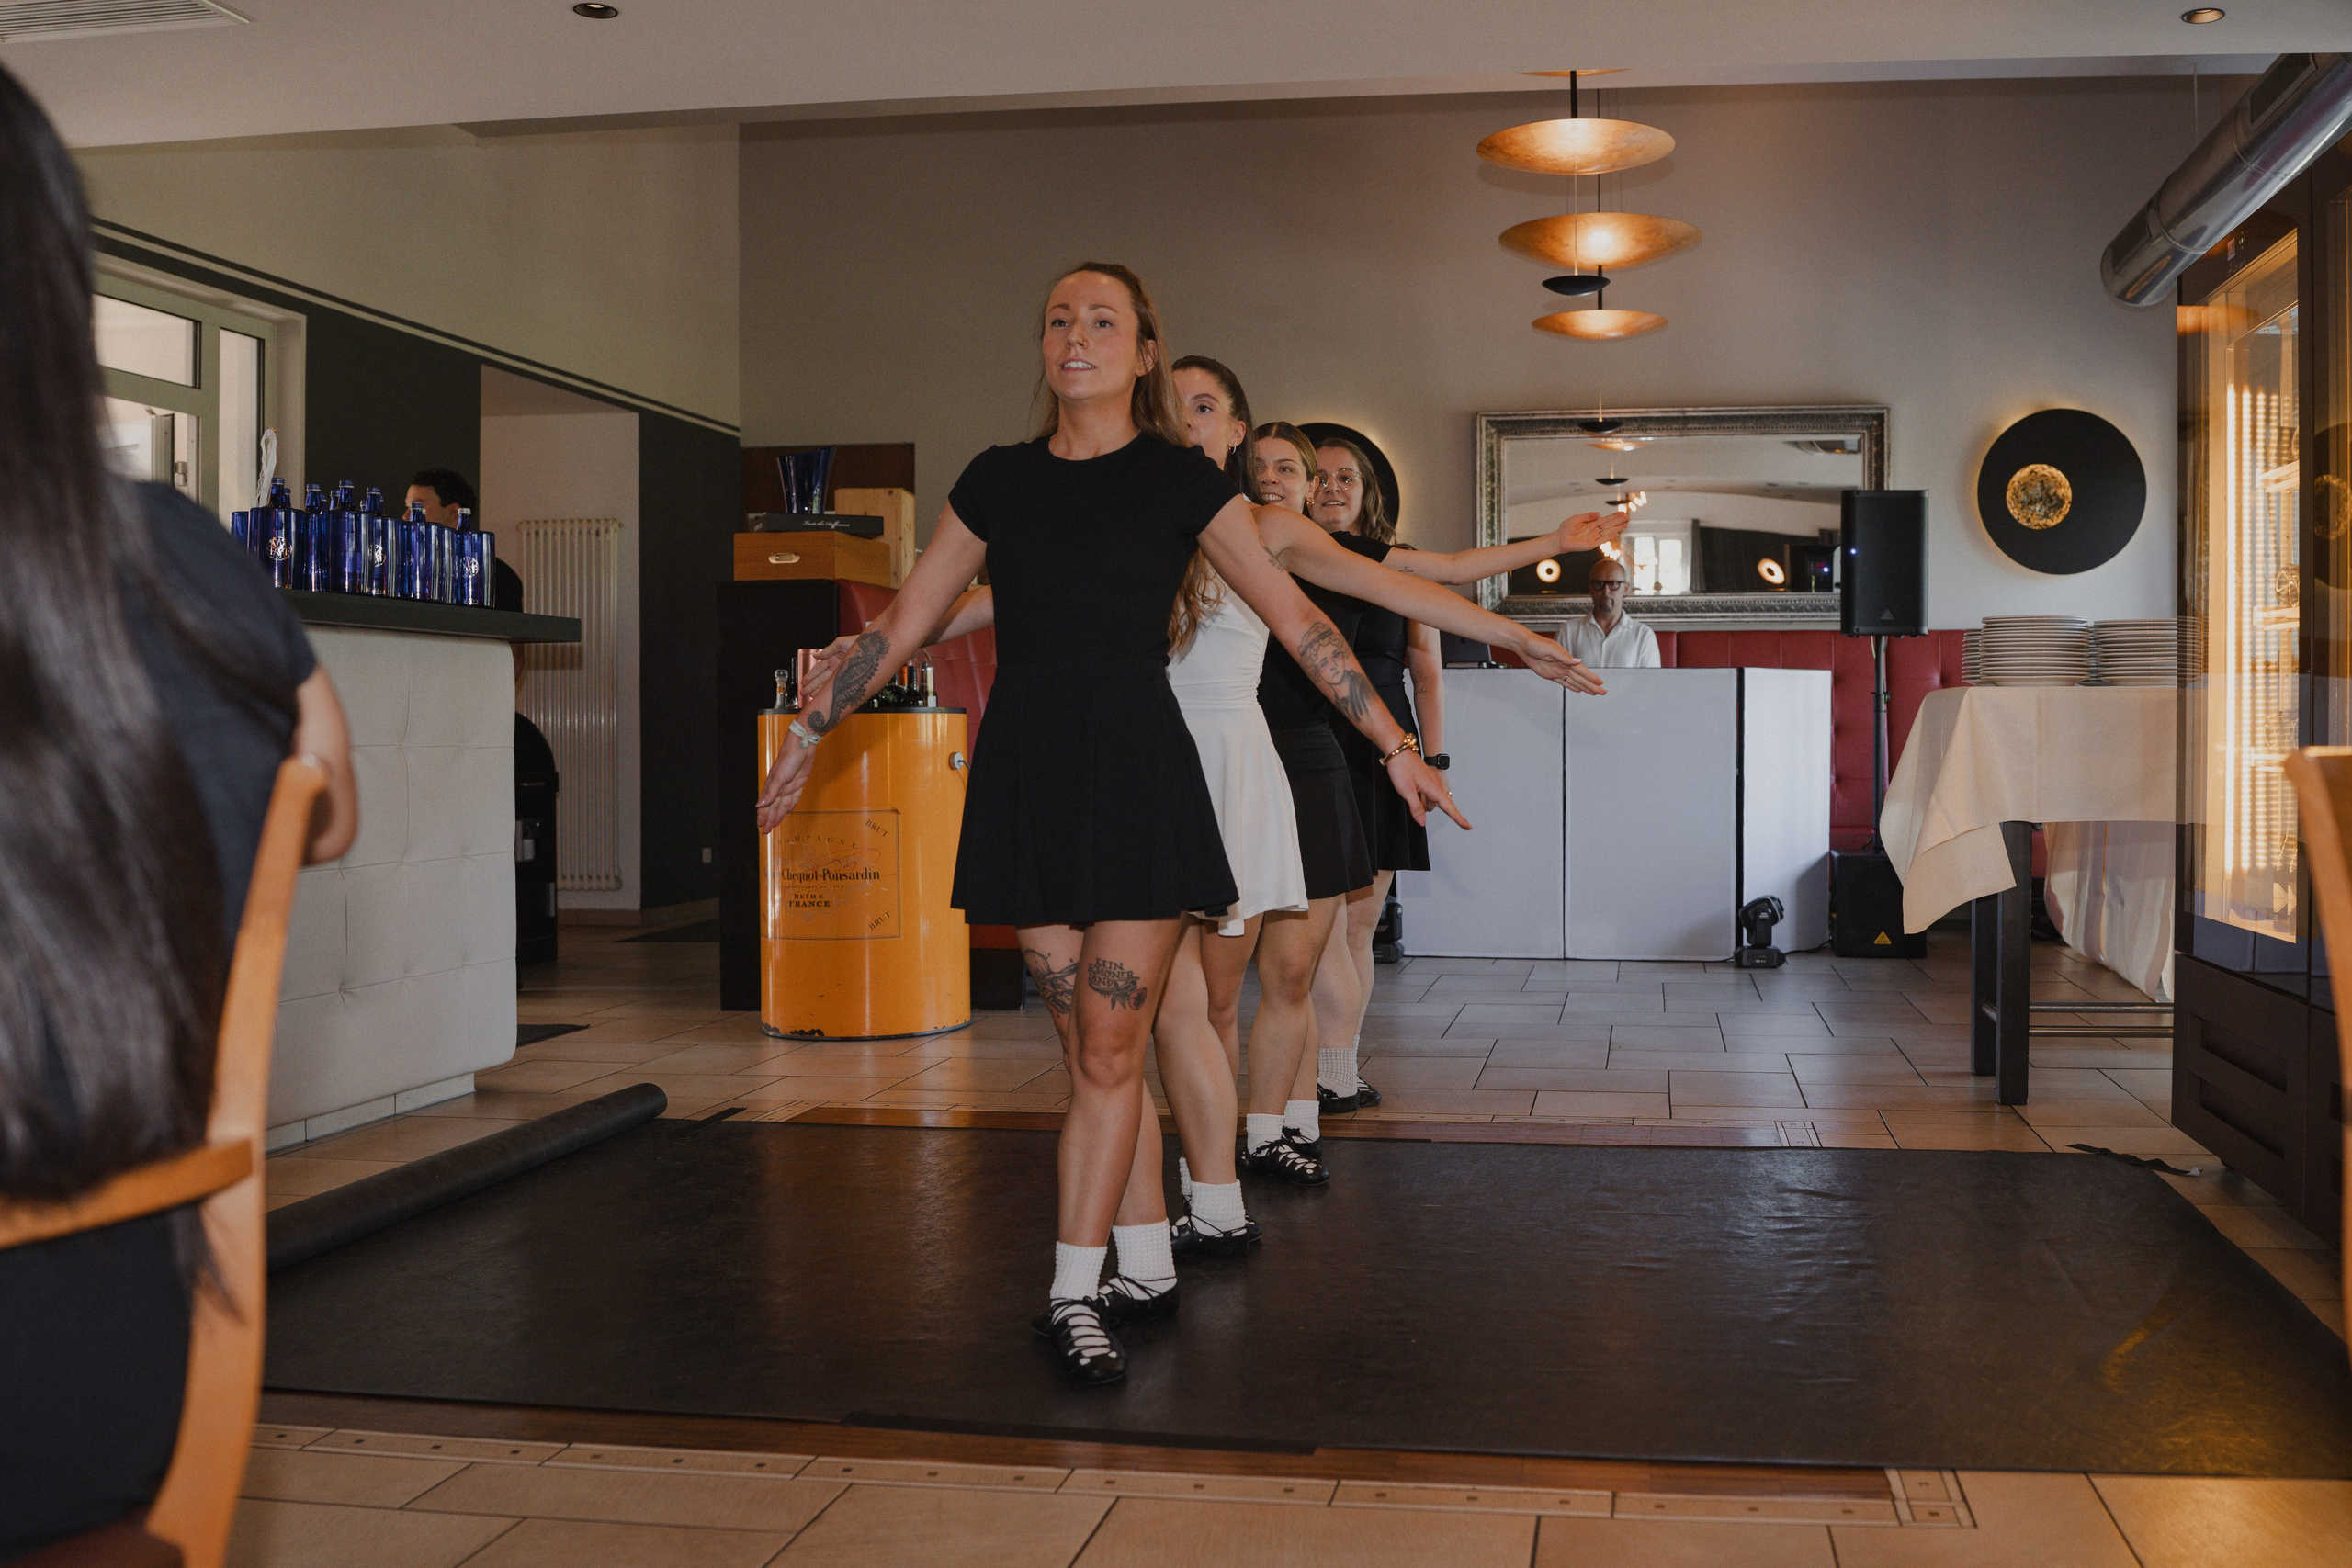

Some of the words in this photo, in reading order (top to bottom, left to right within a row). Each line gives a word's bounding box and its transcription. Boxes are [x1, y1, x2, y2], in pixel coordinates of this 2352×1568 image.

[865, 819, 889, 837] BRUT
[822, 867, 880, 881] Ponsardin
[868, 910, 890, 931] BRUT
